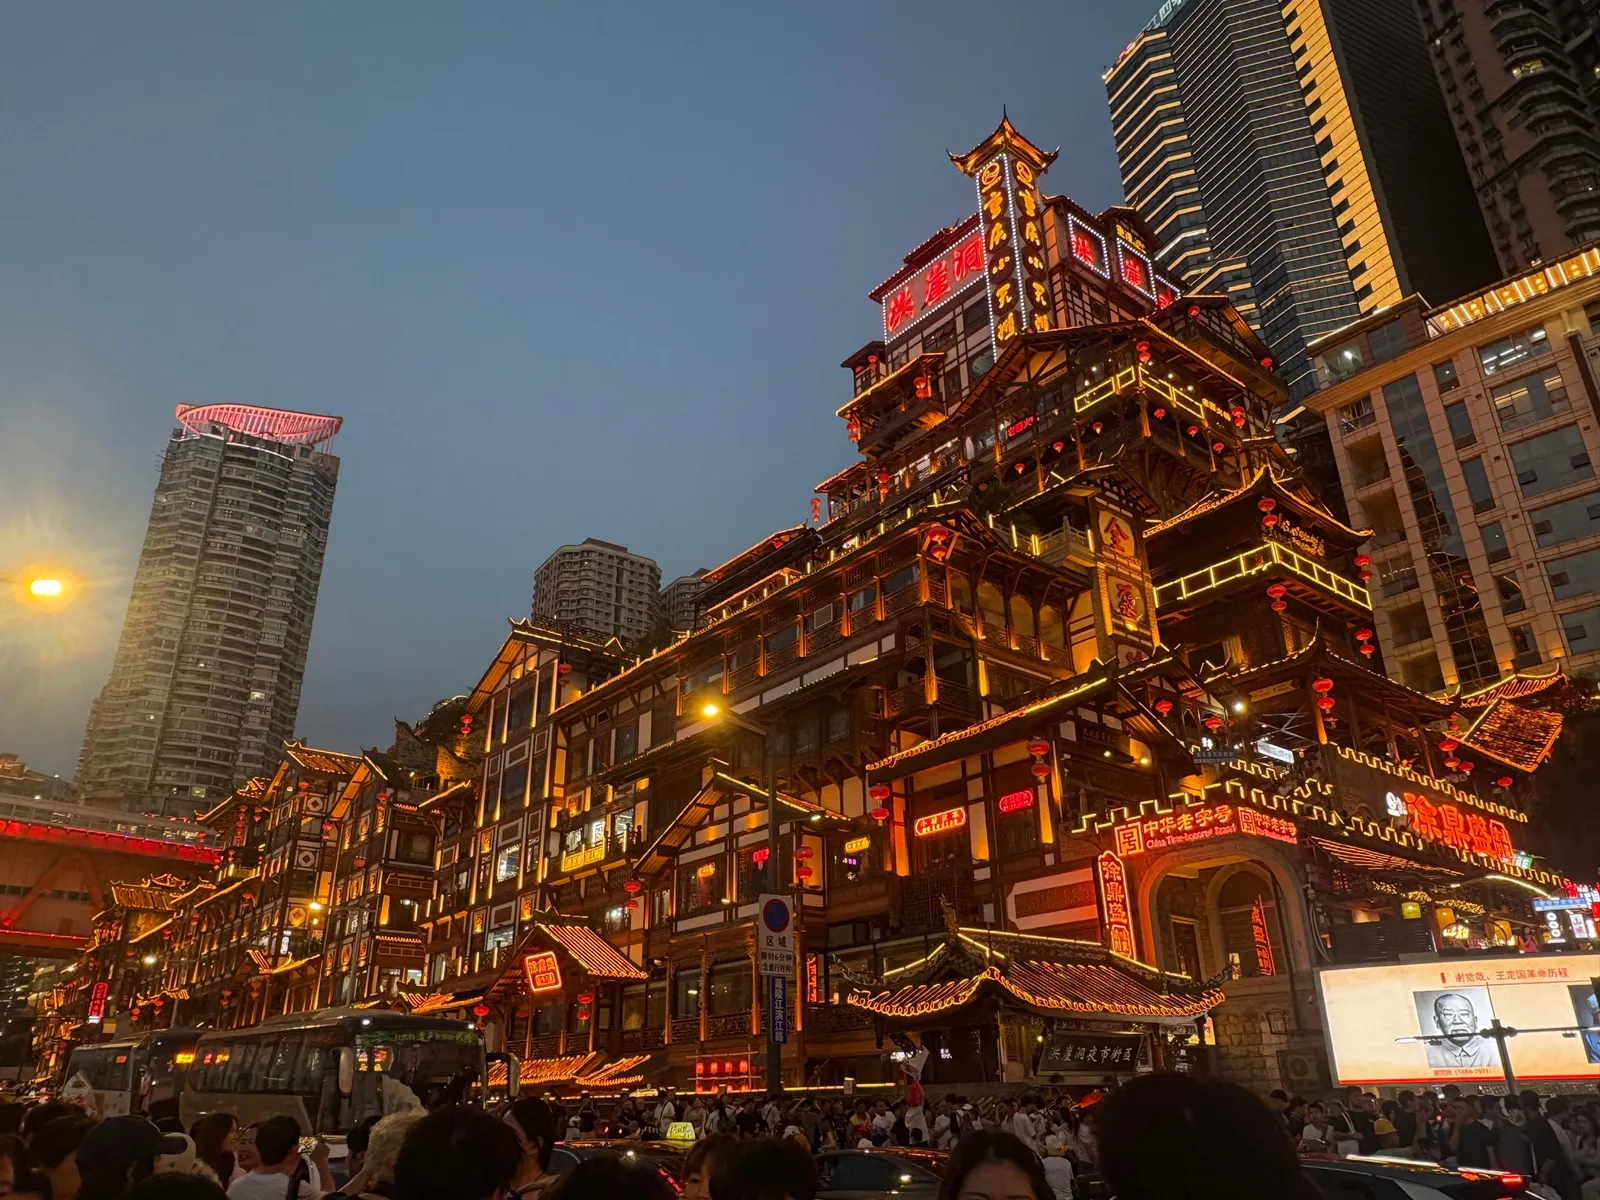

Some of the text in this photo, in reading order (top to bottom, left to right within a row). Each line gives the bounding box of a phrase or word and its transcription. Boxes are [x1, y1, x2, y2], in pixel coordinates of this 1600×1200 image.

[887, 236, 984, 332] 洪崖洞
[1143, 805, 1232, 837] 中华老字号
[766, 935, 786, 947] 区域
[1048, 1044, 1133, 1064] 洪崖洞夜市街区
